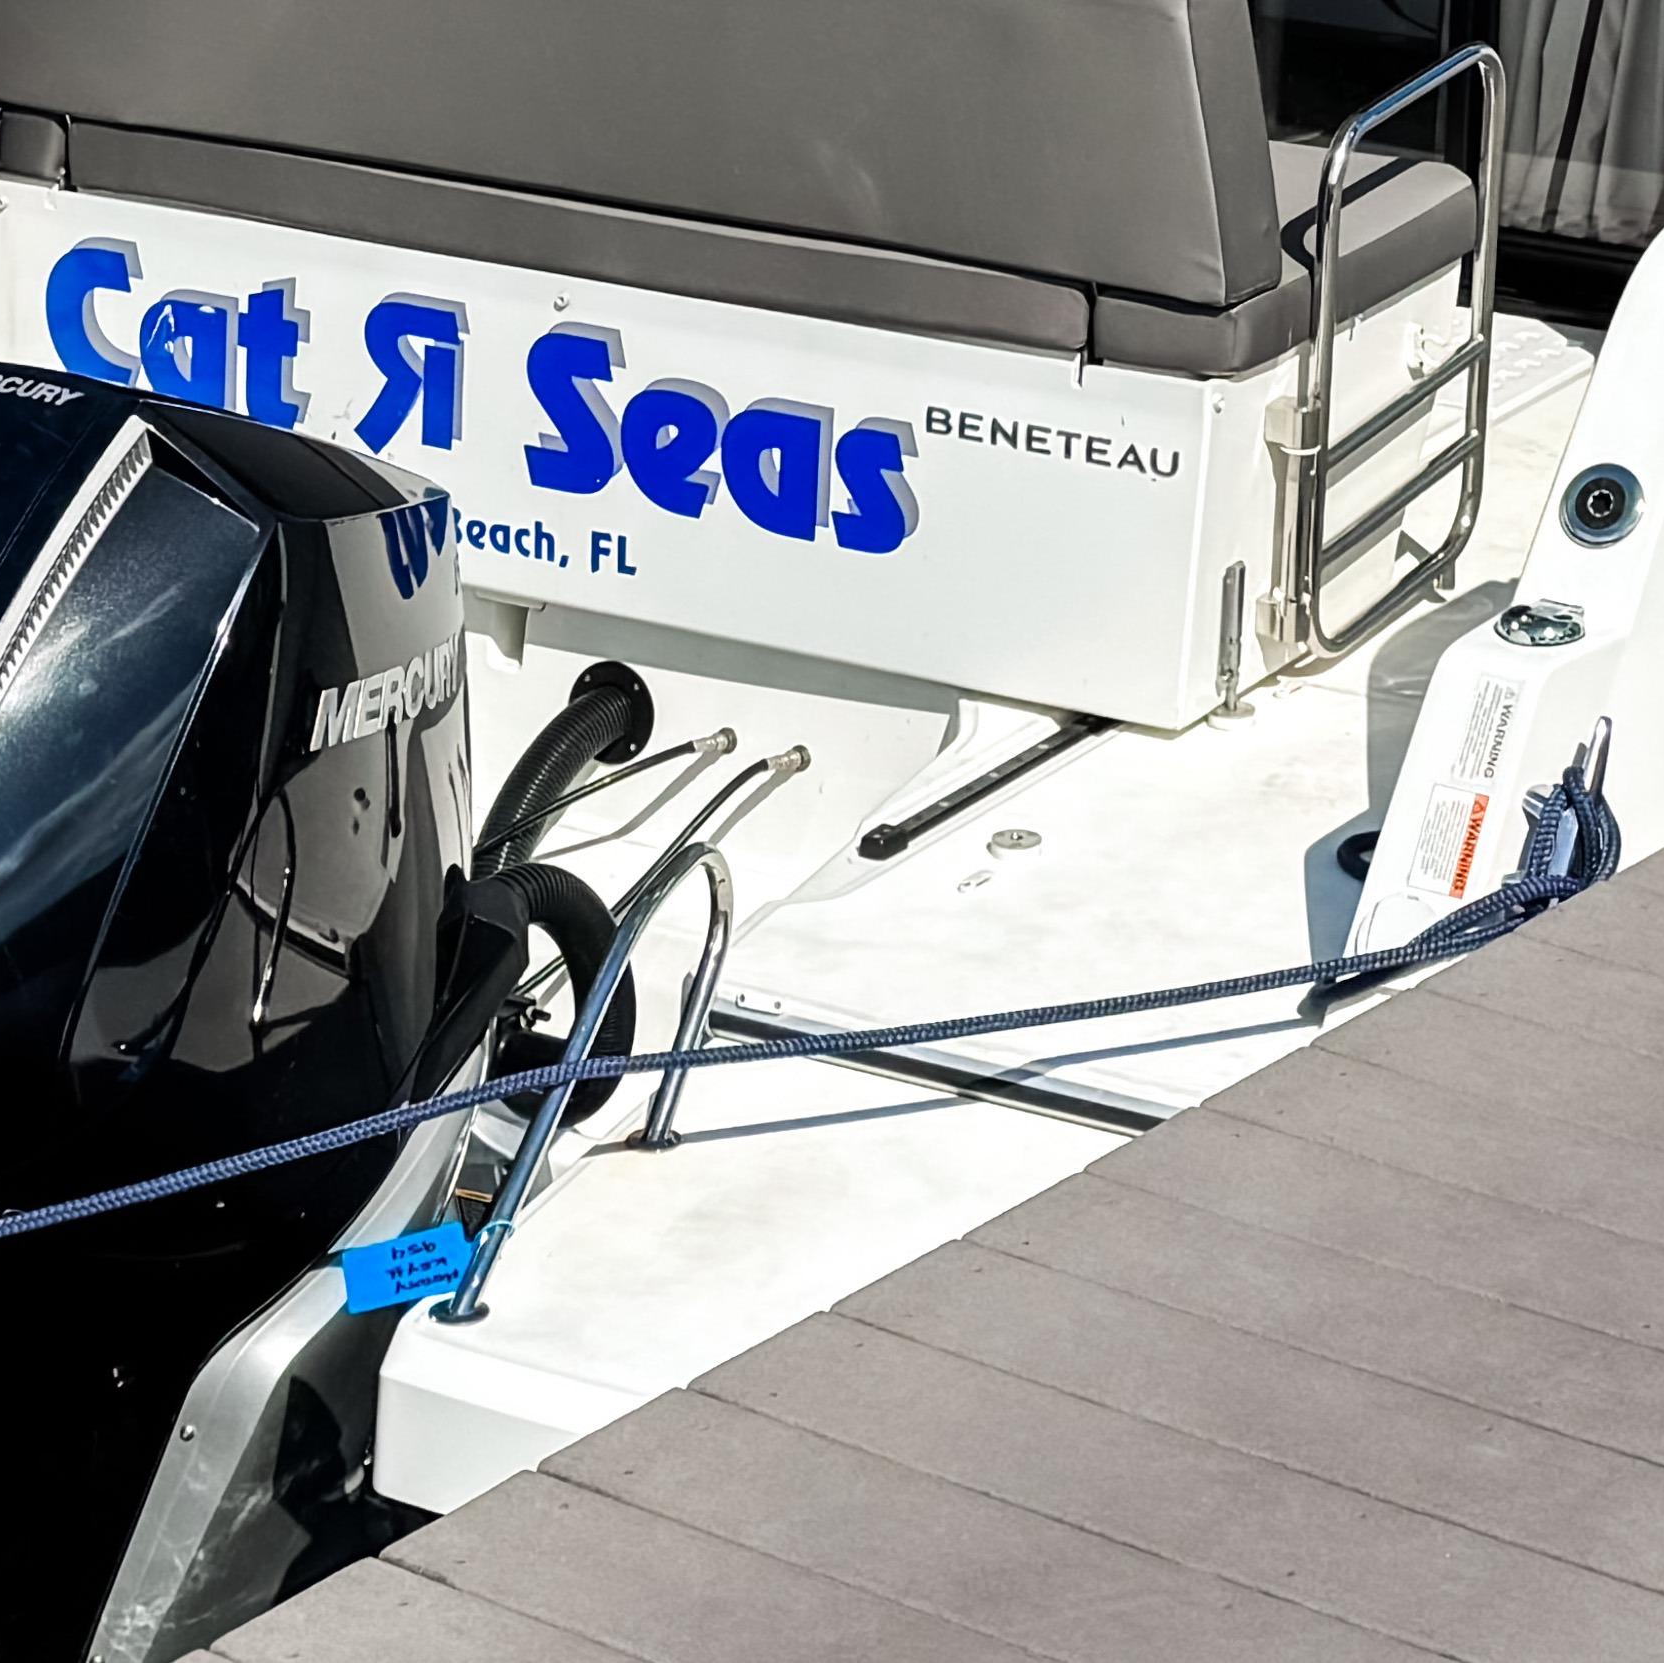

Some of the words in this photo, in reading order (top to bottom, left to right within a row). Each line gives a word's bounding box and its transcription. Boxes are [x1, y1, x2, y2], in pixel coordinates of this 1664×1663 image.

[45, 236, 311, 430] Cat
[524, 320, 920, 555] Seas
[924, 405, 1180, 478] BENETEAU
[591, 530, 637, 576] FL
[1483, 703, 1514, 779] WARNING
[1452, 817, 1484, 891] WARNING
